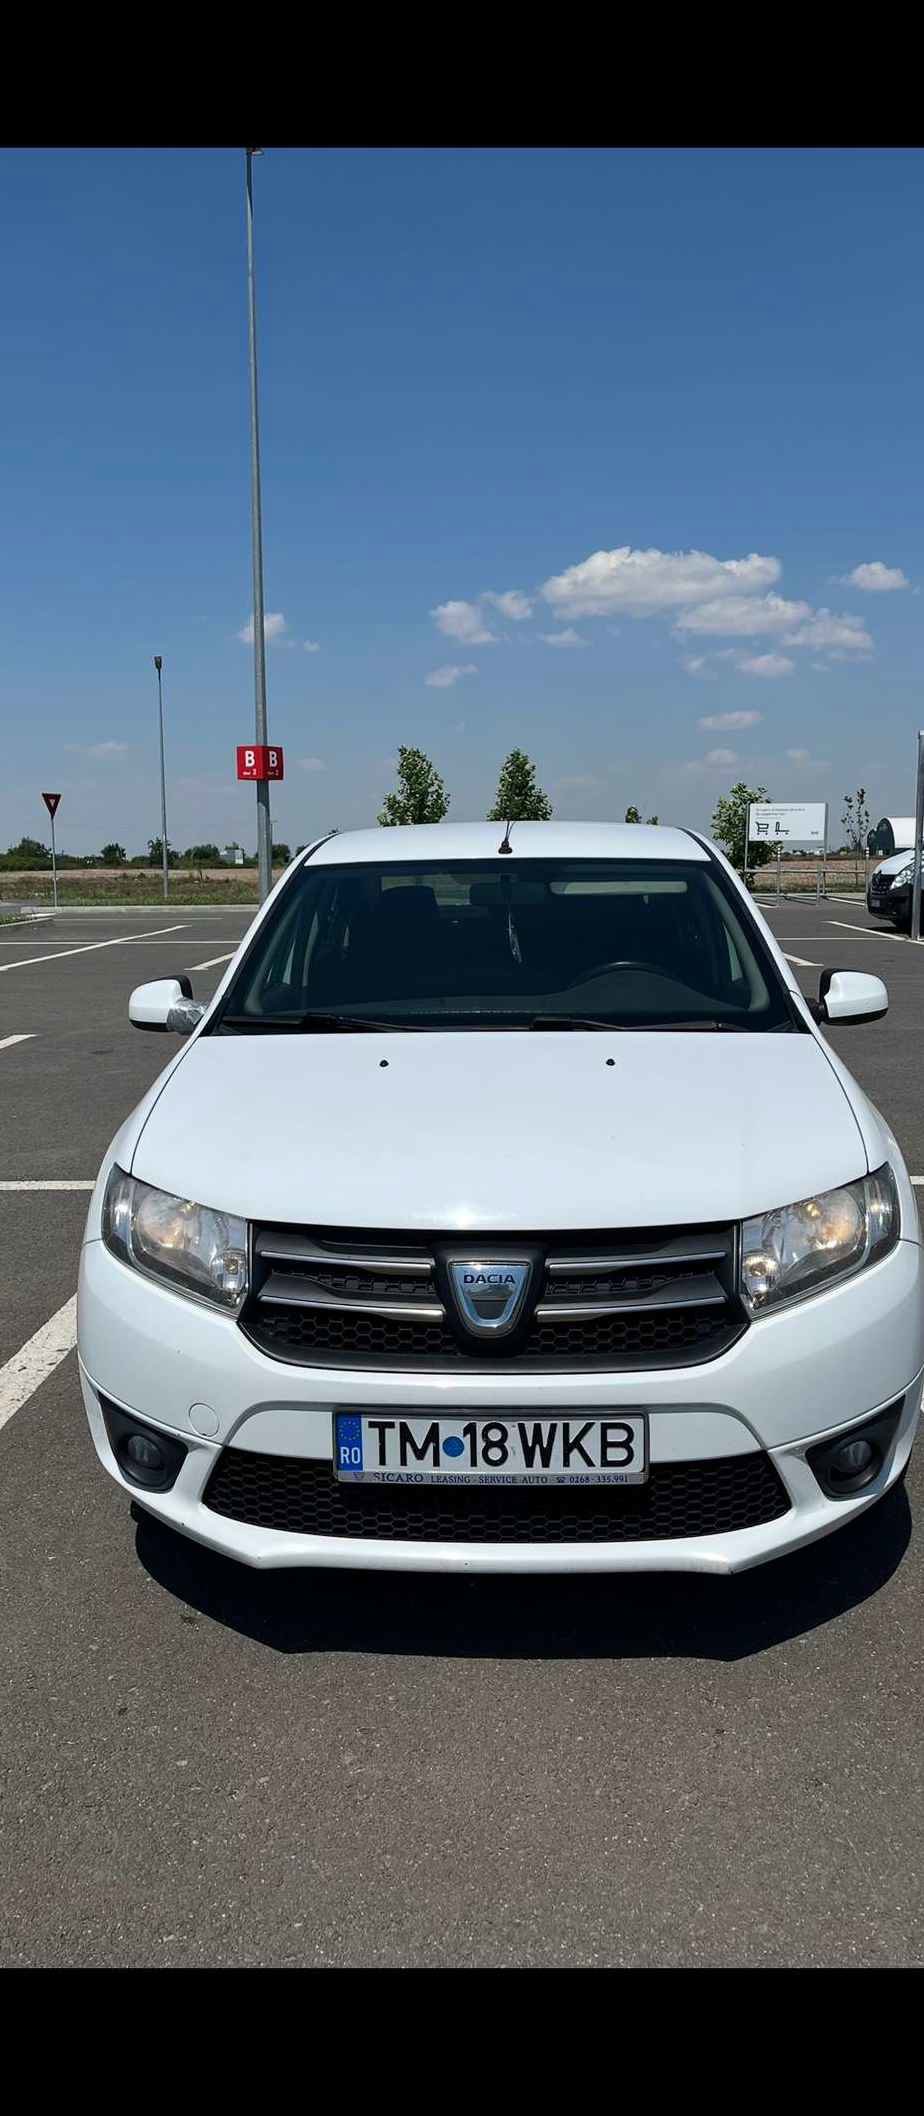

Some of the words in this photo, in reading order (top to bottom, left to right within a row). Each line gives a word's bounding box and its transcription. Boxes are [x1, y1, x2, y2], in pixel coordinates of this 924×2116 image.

[245, 750, 256, 768] B
[269, 750, 278, 768] B
[463, 1274, 516, 1284] DACIA
[367, 1420, 440, 1468] TM
[463, 1421, 509, 1468] 18
[517, 1421, 635, 1469] WKB
[340, 1446, 361, 1465] RO
[373, 1472, 424, 1483] SICARO
[430, 1474, 471, 1484] LEASING
[479, 1474, 518, 1484] SERVICE
[521, 1475, 549, 1484] AUTO
